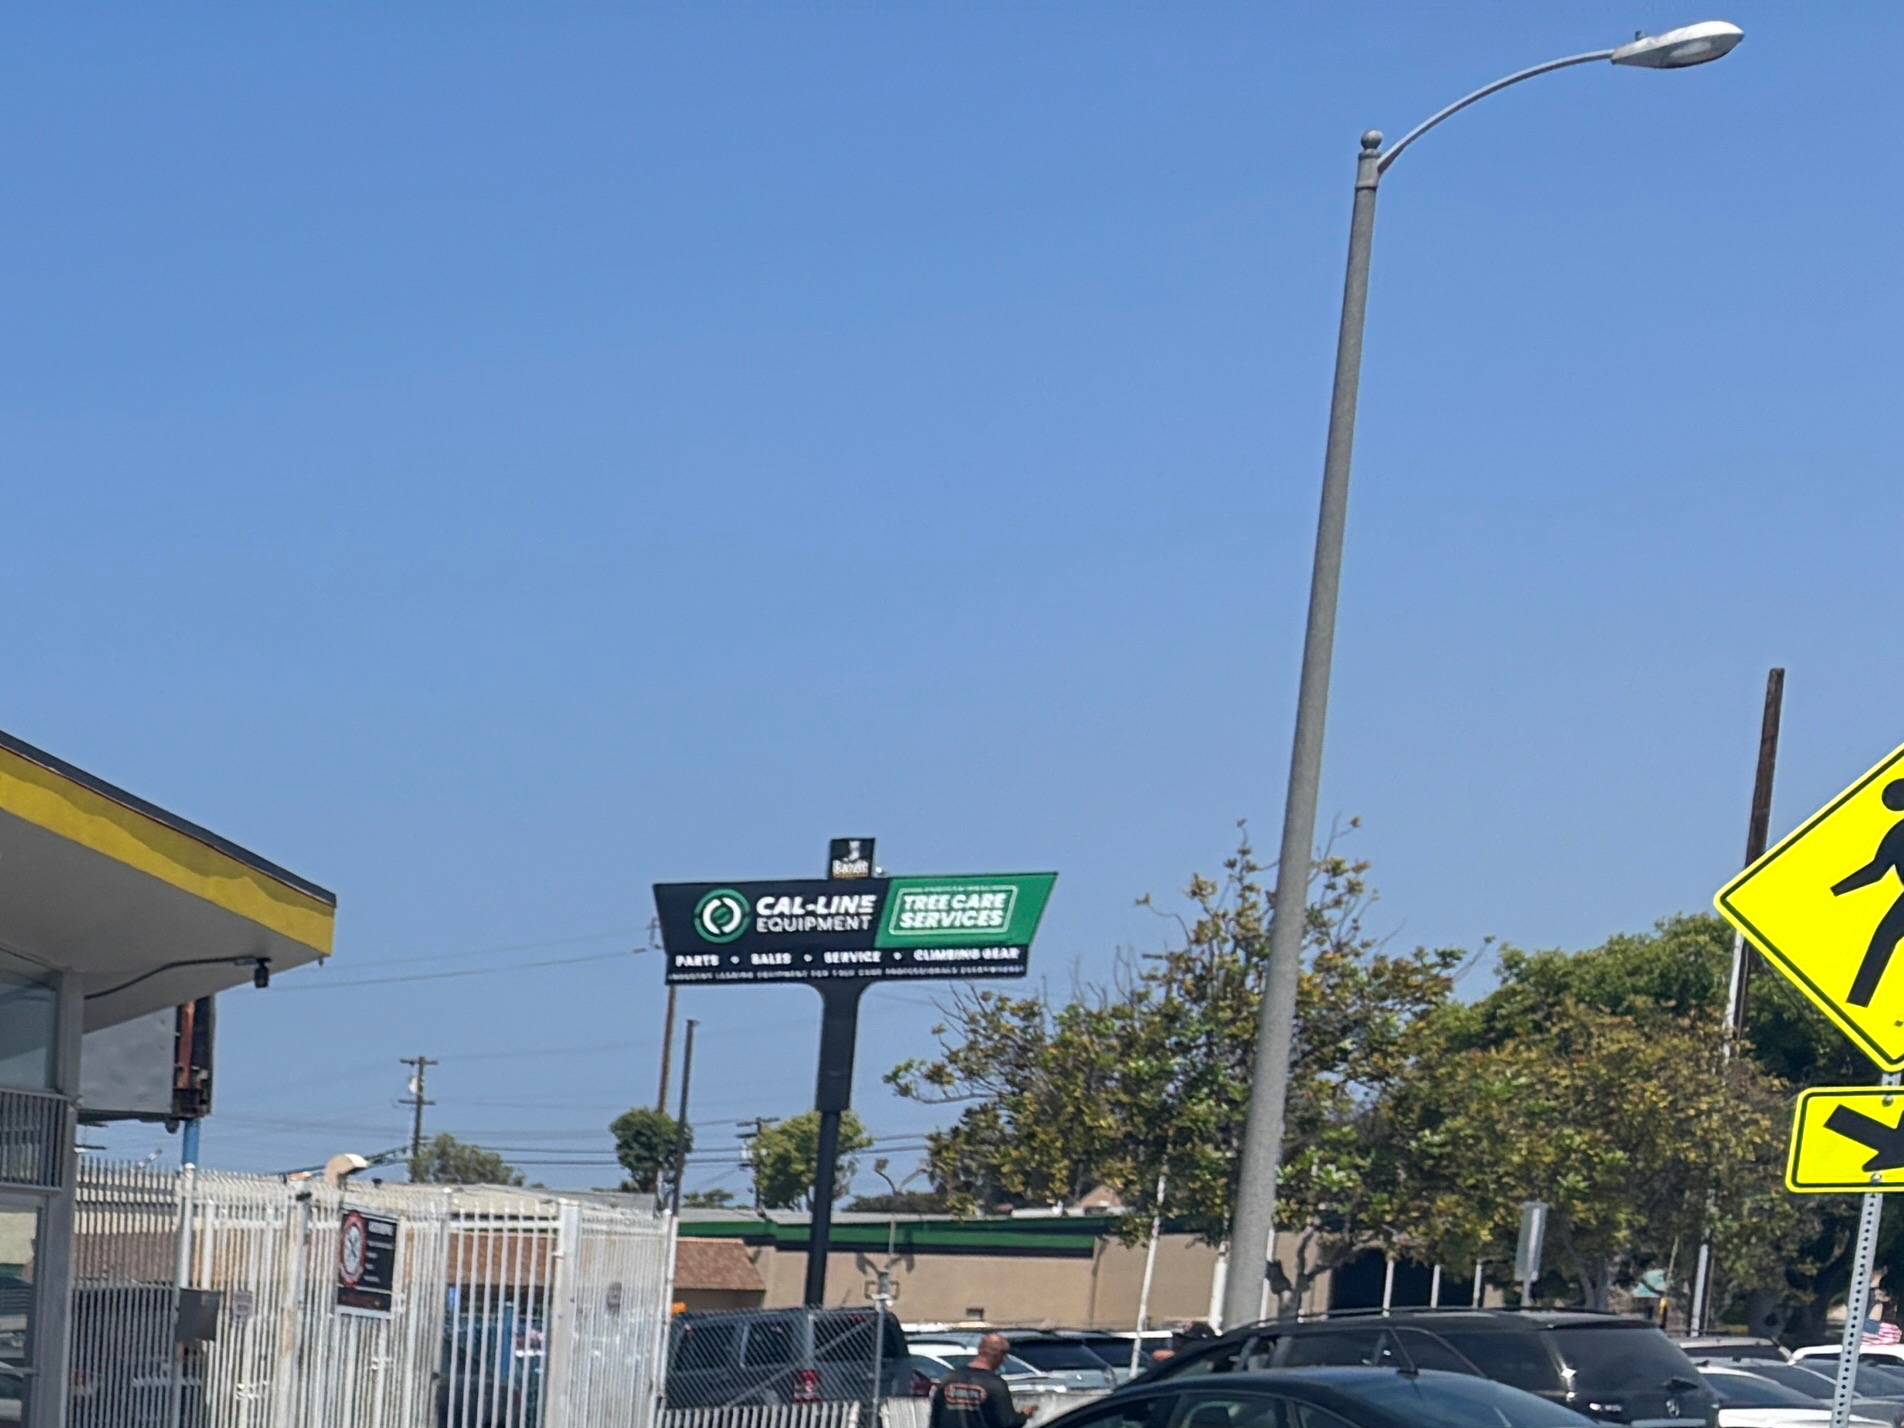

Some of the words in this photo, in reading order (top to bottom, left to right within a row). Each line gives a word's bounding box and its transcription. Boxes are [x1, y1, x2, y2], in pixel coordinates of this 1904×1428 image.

[756, 894, 877, 916] CAL-LINE
[903, 894, 951, 911] TREE
[951, 892, 1007, 910] CARE
[756, 915, 872, 932] EQUIPMENT
[899, 910, 1003, 929] SERVICES
[675, 954, 720, 967] PARTS
